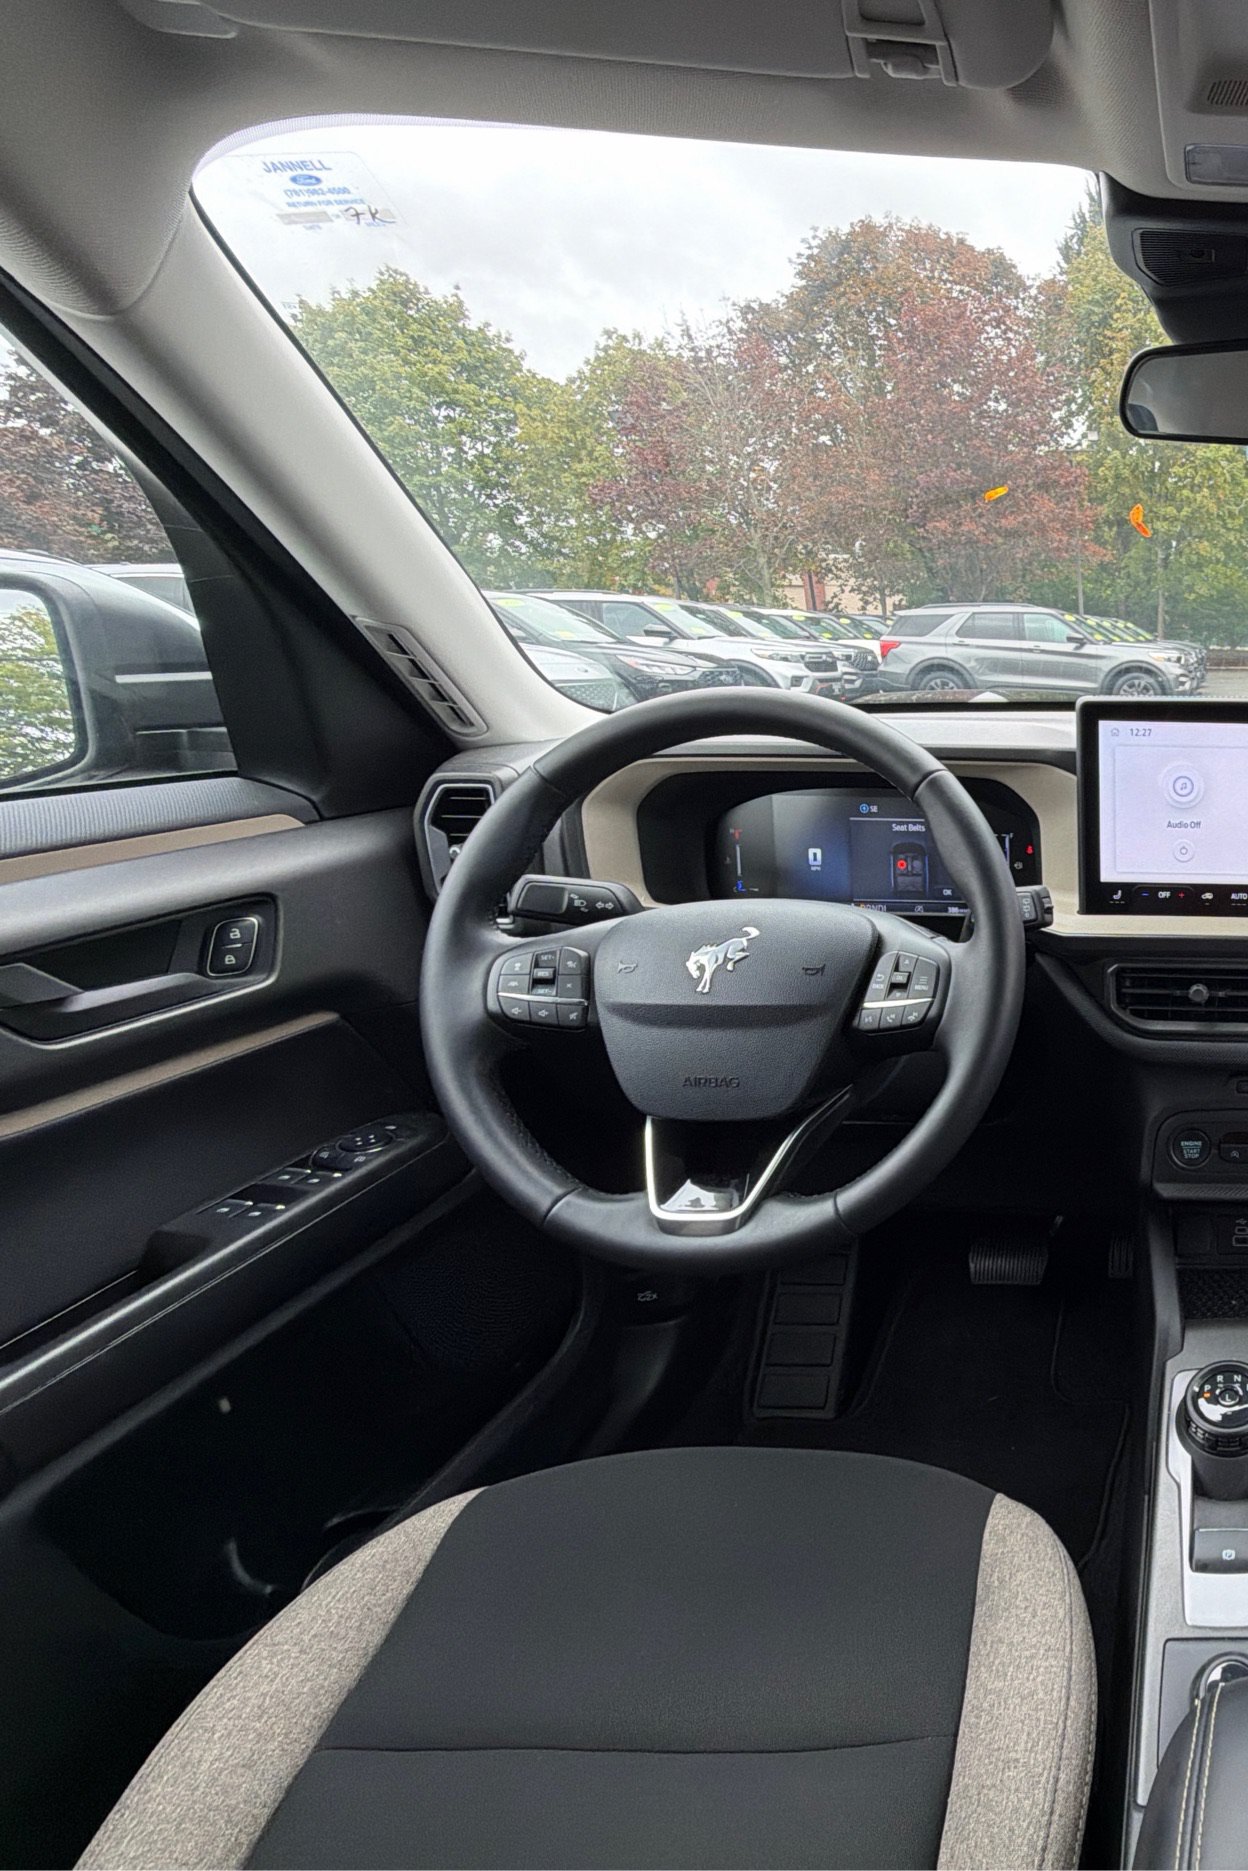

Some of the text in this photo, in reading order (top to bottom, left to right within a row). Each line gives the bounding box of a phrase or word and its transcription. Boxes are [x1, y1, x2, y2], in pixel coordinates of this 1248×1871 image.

[262, 159, 332, 173] JANNELL
[1129, 728, 1152, 737] 12:27
[892, 823, 926, 832] Seat Belts
[1166, 820, 1201, 829] Audio Off
[1158, 891, 1171, 899] OFF
[682, 1076, 740, 1088] AIRBAG
